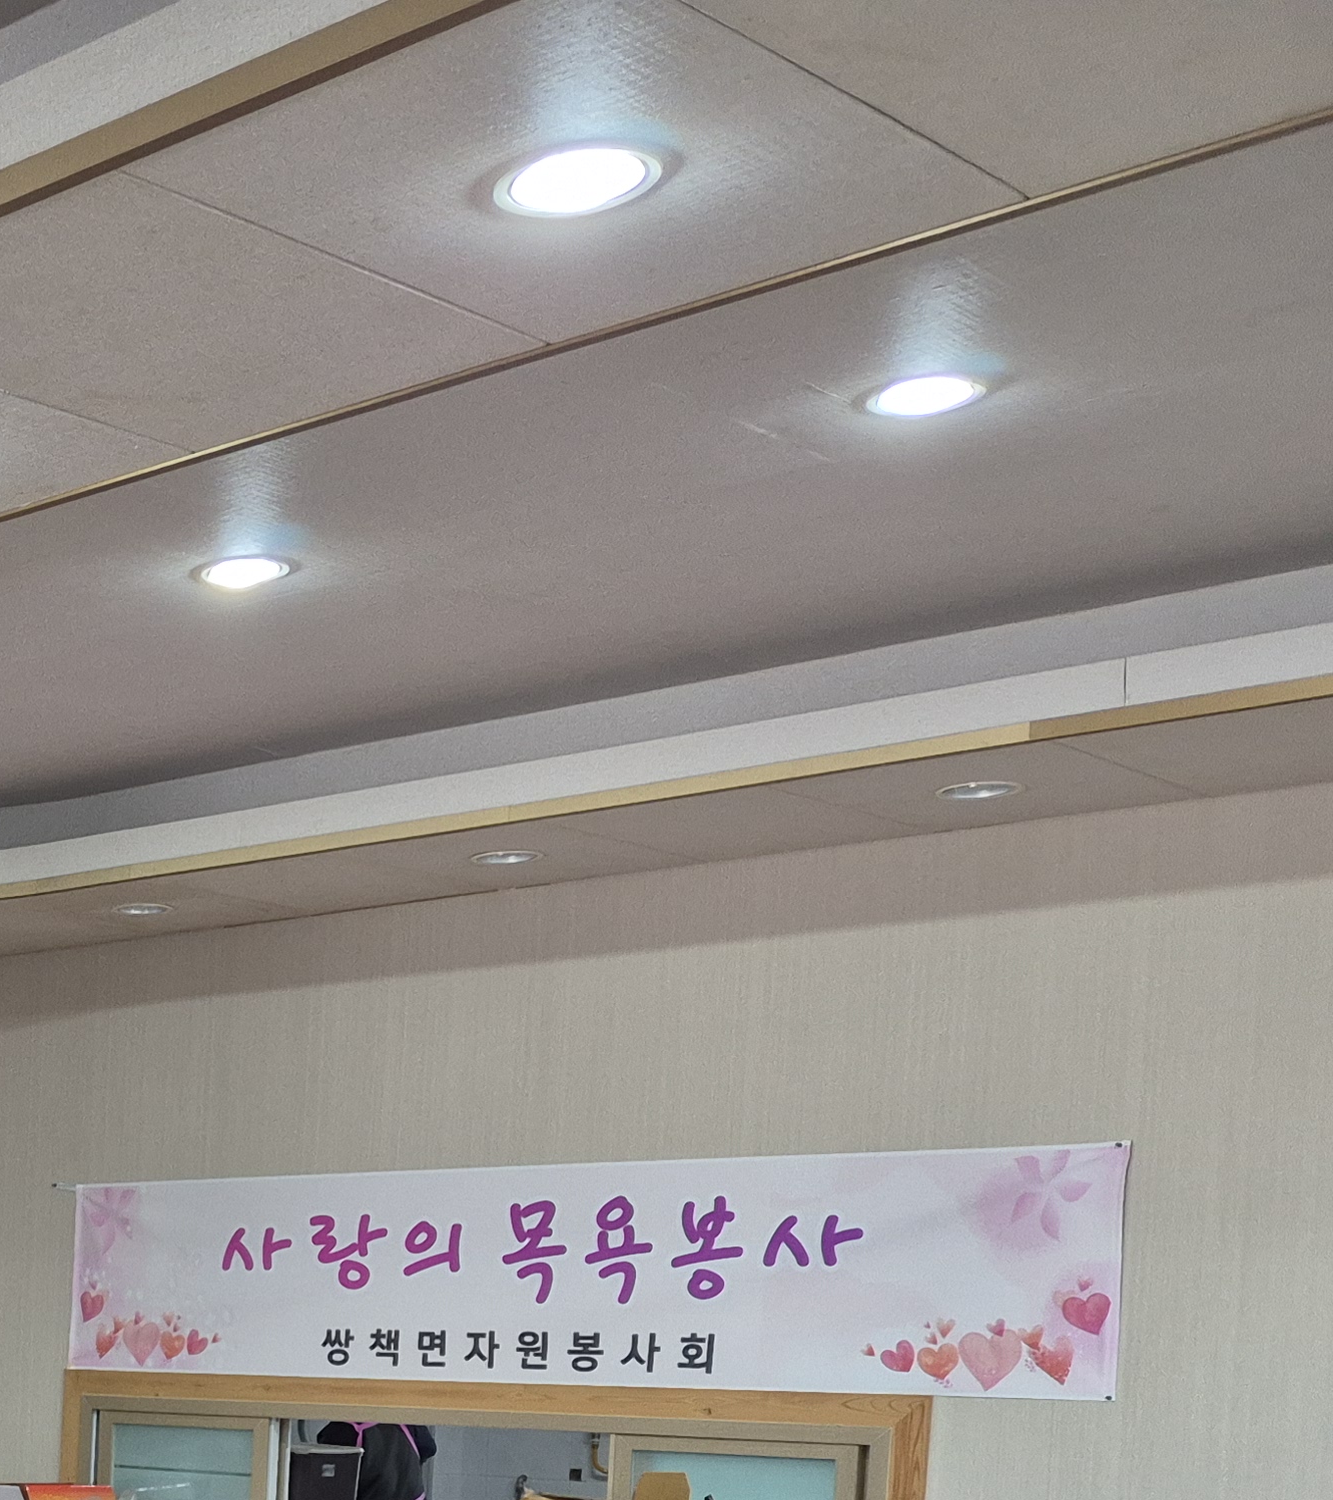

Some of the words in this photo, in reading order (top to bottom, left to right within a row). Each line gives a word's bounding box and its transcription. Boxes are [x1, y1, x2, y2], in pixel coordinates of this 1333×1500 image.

[221, 1213, 463, 1290] 사랑의
[501, 1194, 865, 1304] 목욕봉사
[320, 1328, 716, 1374] 쌍책면자원봉사회
